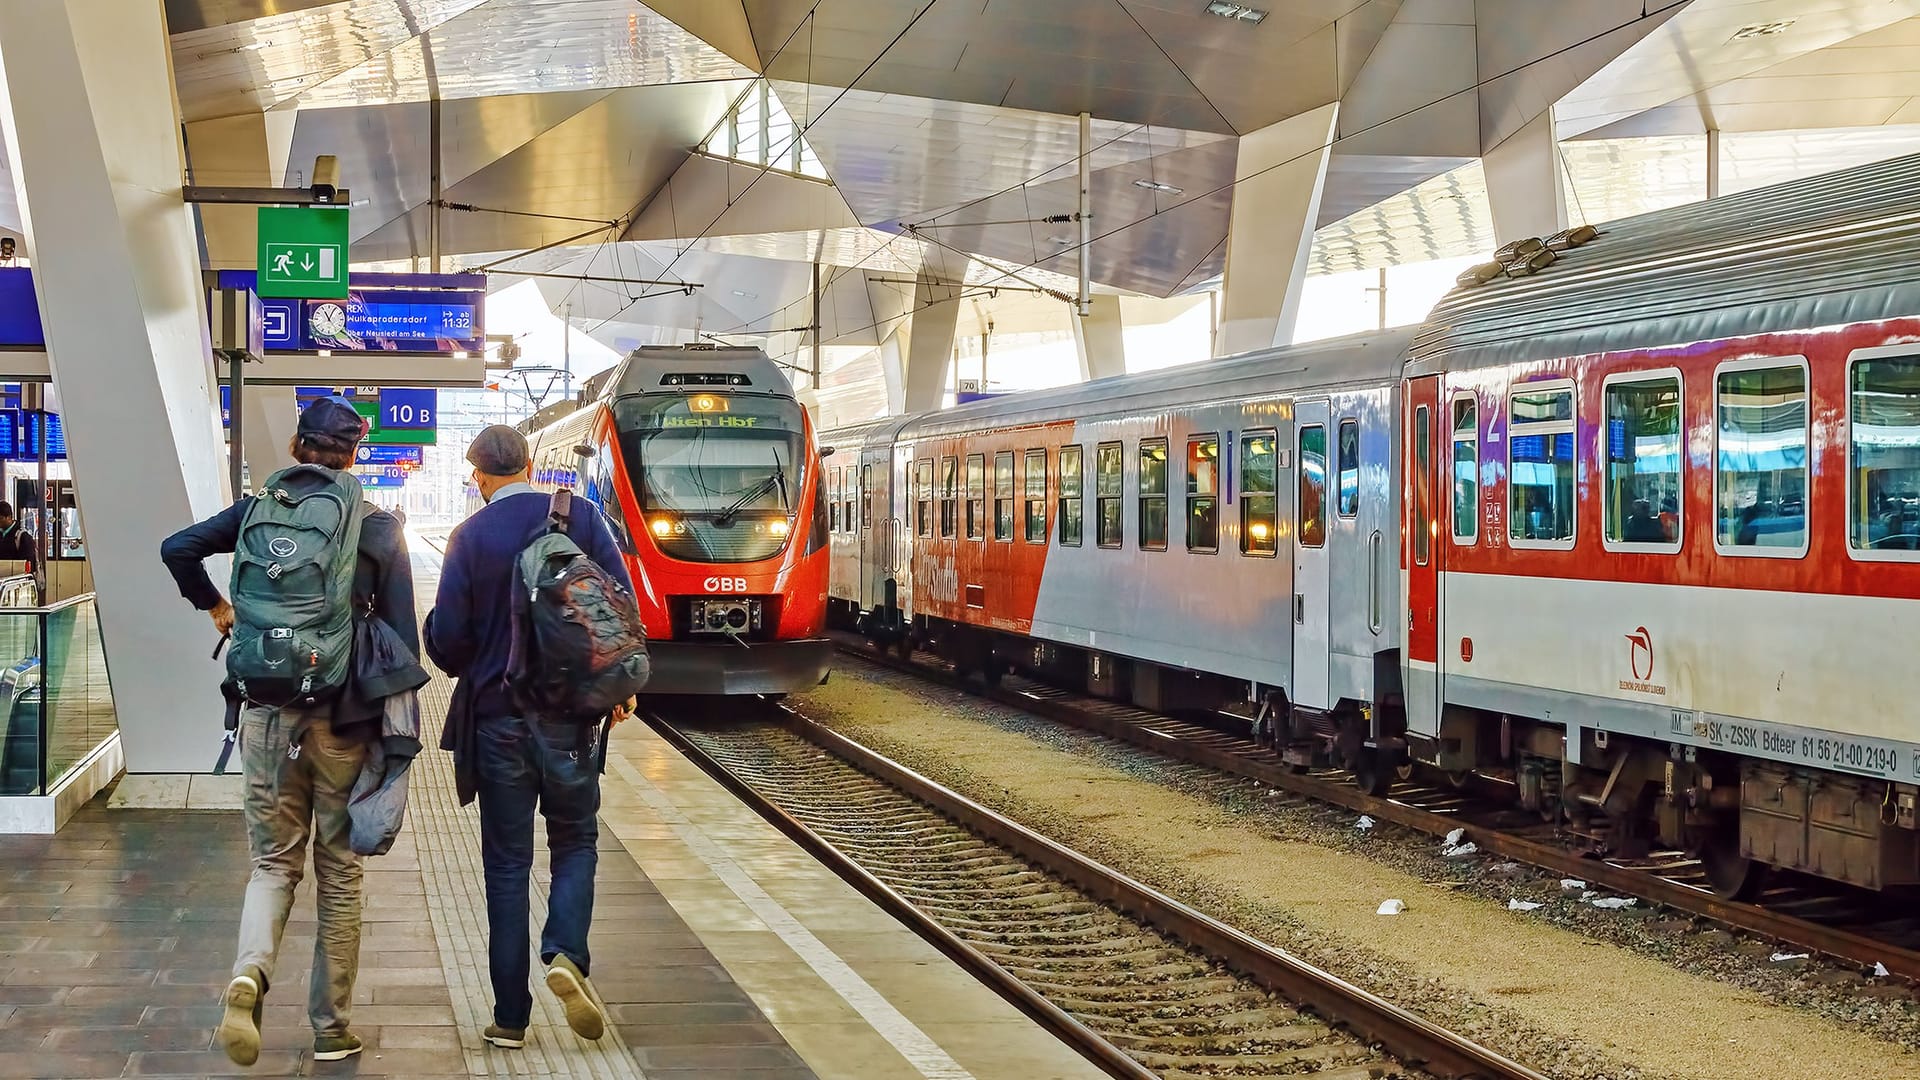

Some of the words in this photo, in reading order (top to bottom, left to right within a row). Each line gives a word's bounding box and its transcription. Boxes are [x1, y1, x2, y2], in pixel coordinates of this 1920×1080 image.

[346, 304, 363, 313] REX
[442, 318, 470, 328] 11:32
[412, 330, 426, 338] See
[964, 382, 975, 390] 70
[389, 404, 413, 423] 10
[420, 409, 430, 423] B
[1487, 394, 1500, 442] 2
[663, 416, 711, 428] Wien
[719, 416, 758, 428] Hbf
[386, 468, 399, 478] 10
[703, 577, 748, 592] ÖBB
[1709, 721, 1723, 742] SK
[1730, 725, 1757, 748] ZSSK
[1763, 730, 1796, 755] Bdteer
[1802, 736, 1814, 758] 61
[1818, 739, 1831, 761] 56
[1833, 741, 1863, 766] 21-00
[1866, 746, 1897, 772] 219-0
